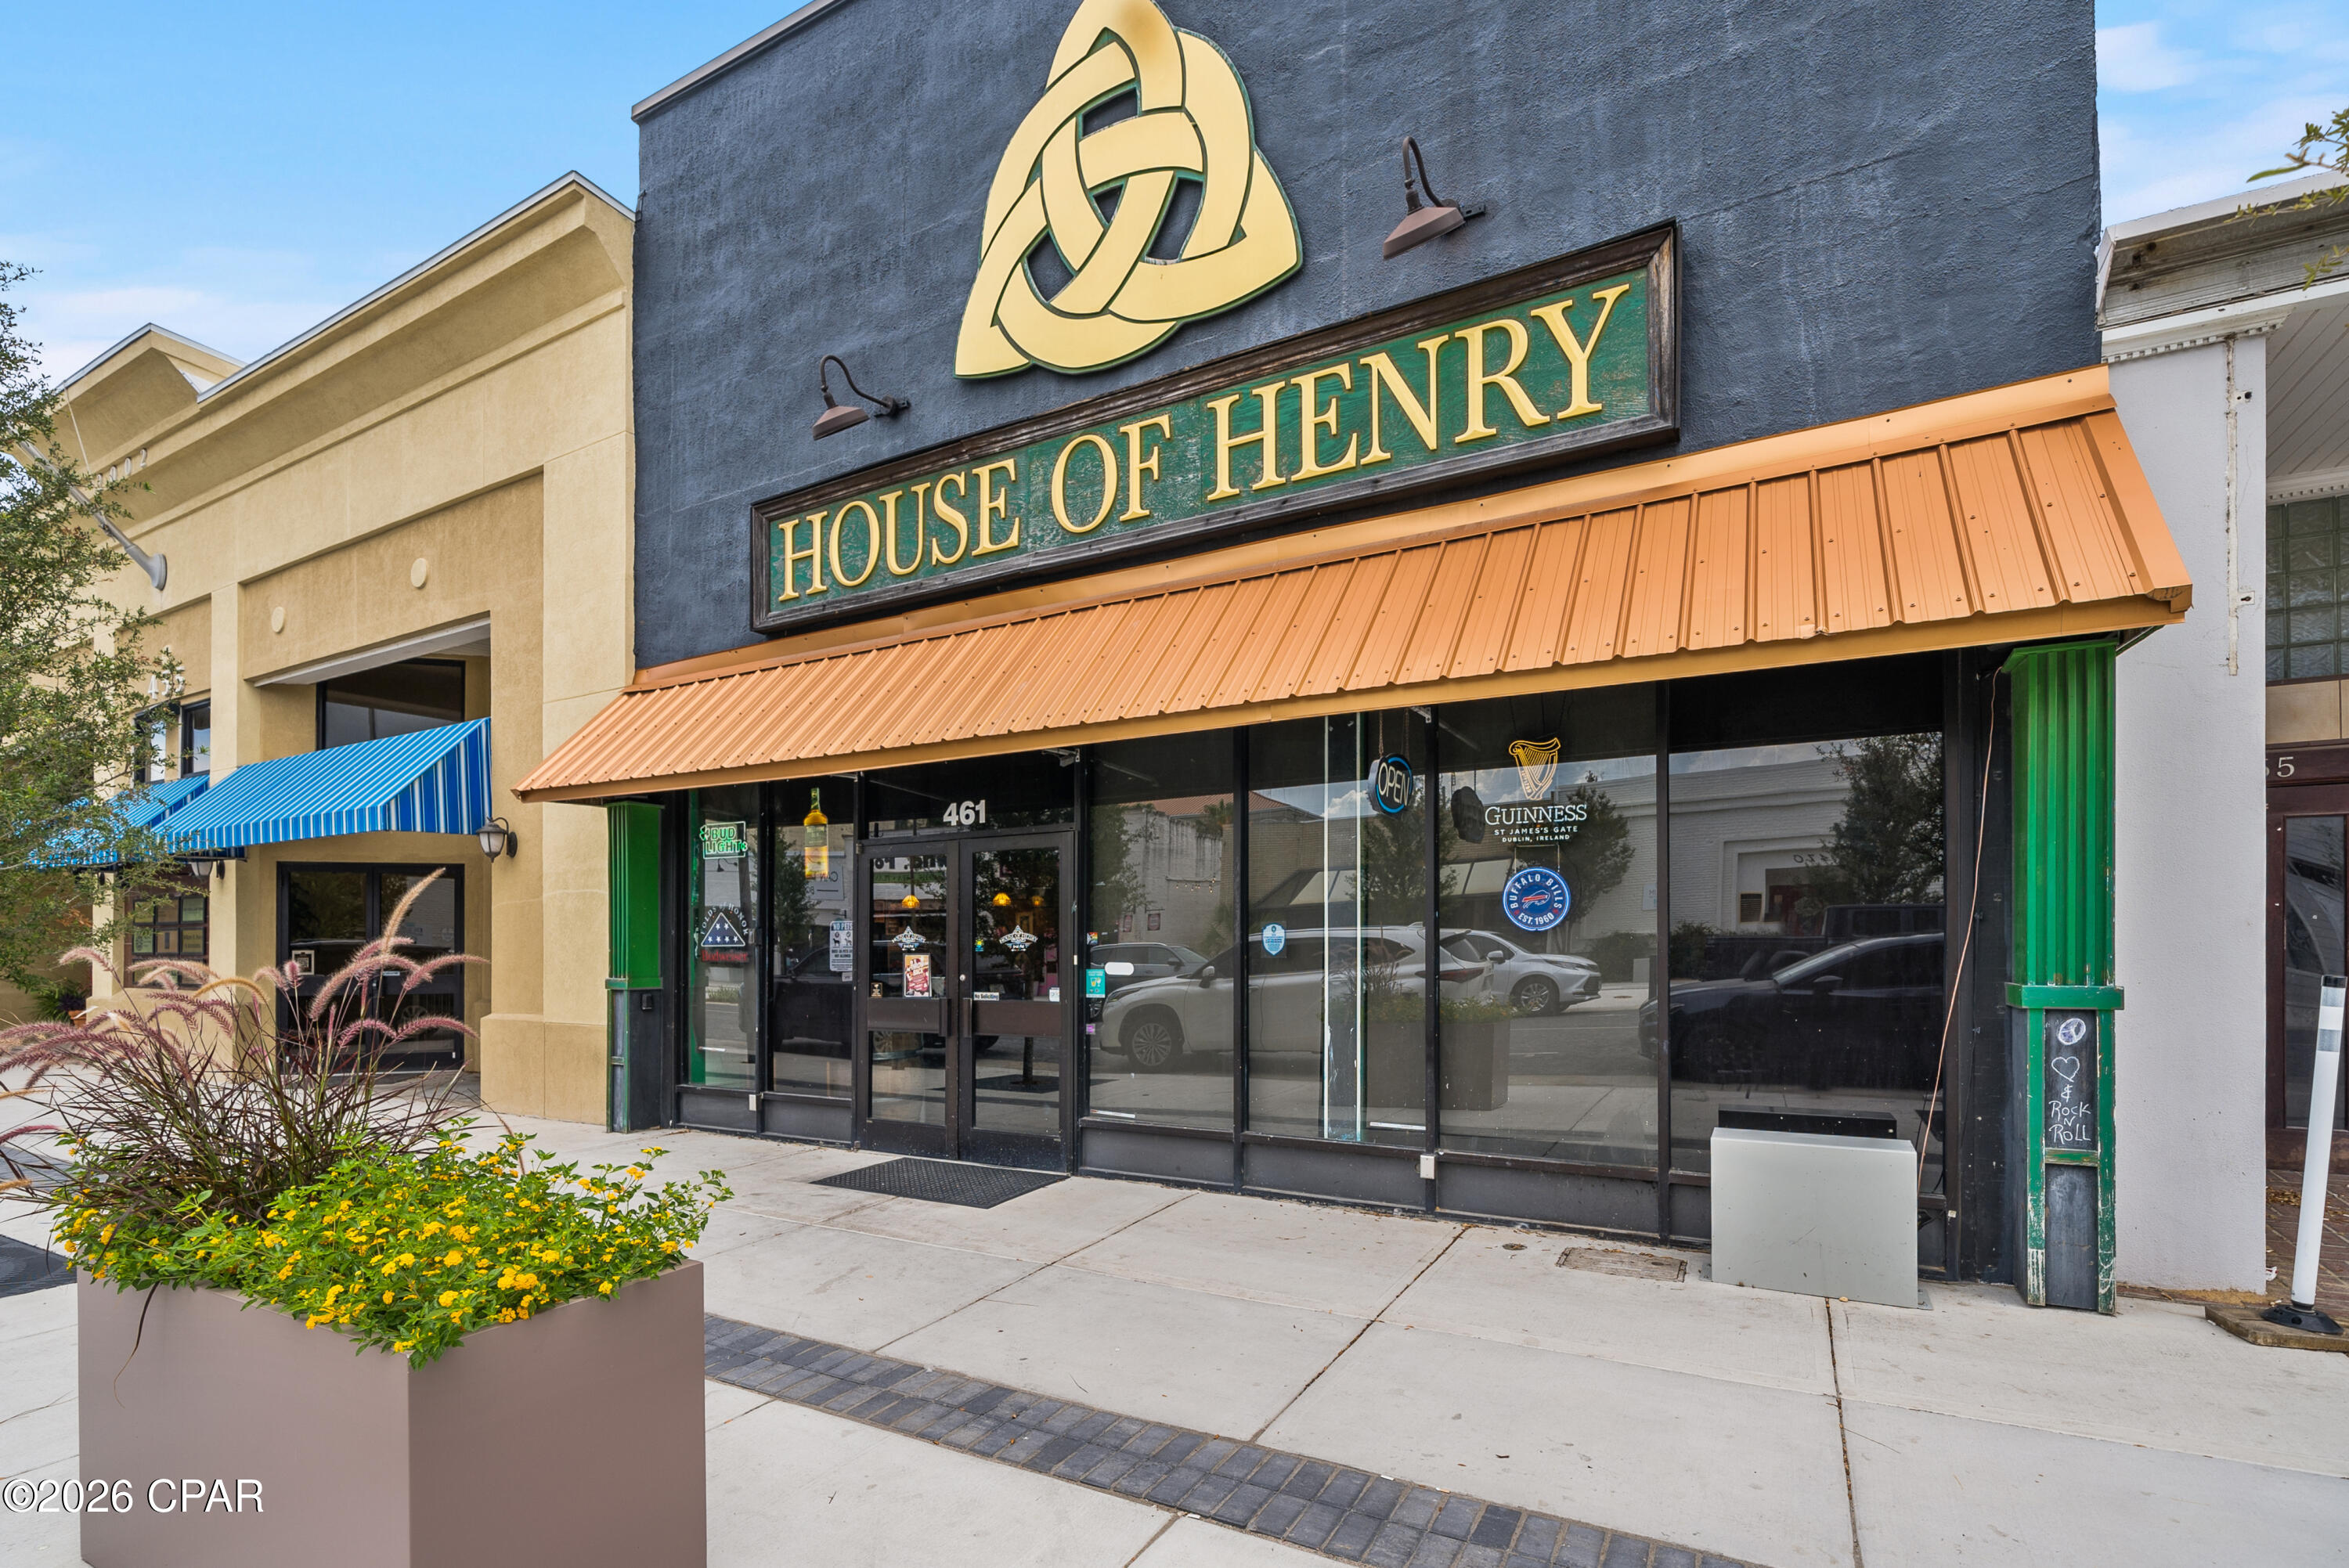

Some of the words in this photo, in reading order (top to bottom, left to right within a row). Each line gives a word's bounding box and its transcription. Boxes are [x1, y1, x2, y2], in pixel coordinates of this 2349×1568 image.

[778, 458, 1019, 601] HOUSE
[1051, 414, 1171, 534] OF
[1207, 283, 1630, 502] HENRY
[1378, 762, 1410, 806] OPEN
[943, 799, 986, 827] 461
[1485, 804, 1587, 825] GUINNESS
[710, 826, 737, 840] BUD
[1509, 827, 1549, 835] JAMES'S
[705, 839, 742, 854] LIGHT
[1509, 874, 1541, 909] BUFFALO
[1546, 878, 1563, 909] BILLS
[832, 922, 840, 931] NO
[1518, 912, 1533, 925] EST.
[1535, 912, 1554, 925] 1960
